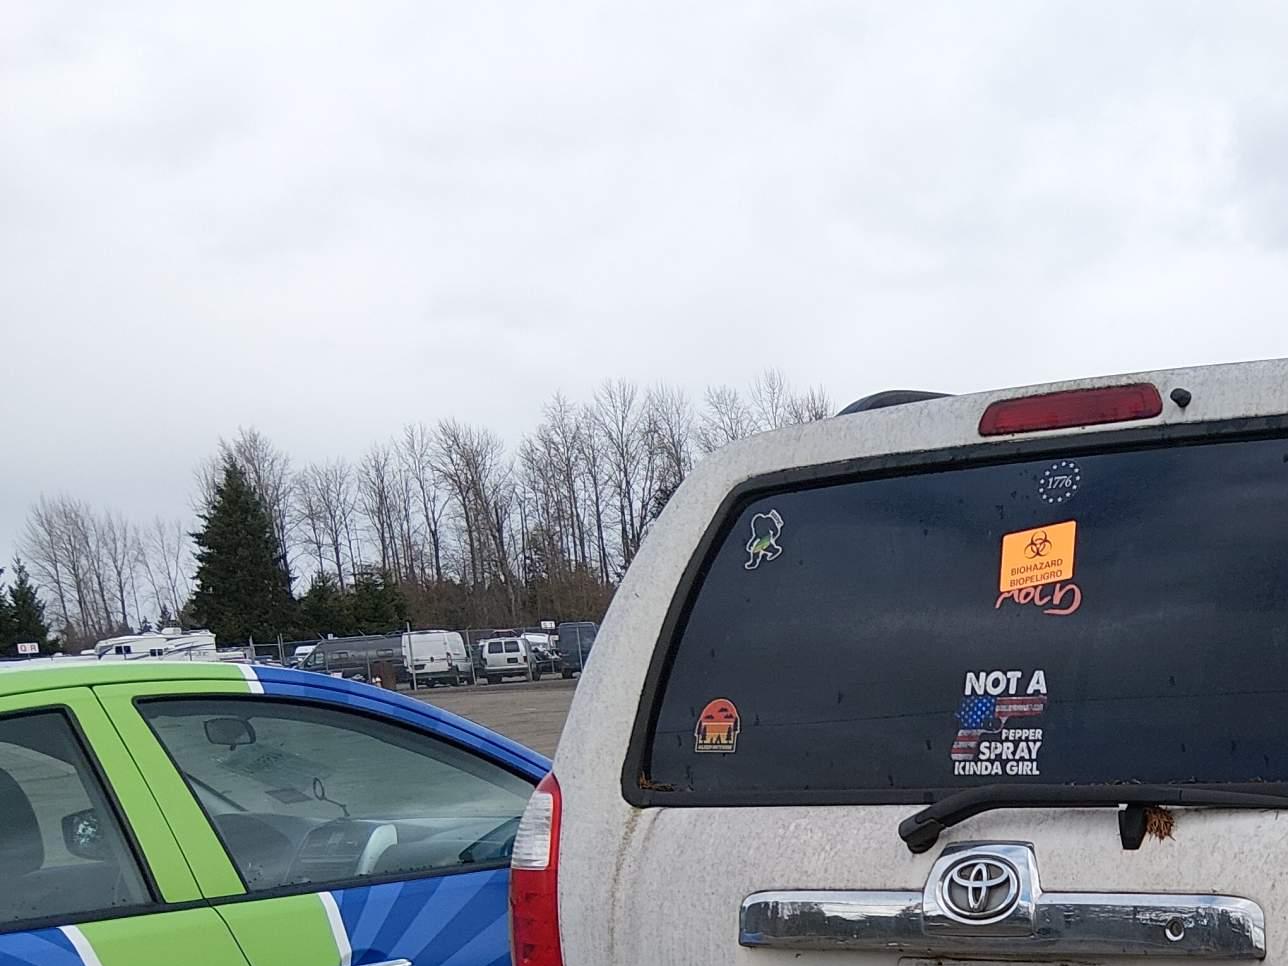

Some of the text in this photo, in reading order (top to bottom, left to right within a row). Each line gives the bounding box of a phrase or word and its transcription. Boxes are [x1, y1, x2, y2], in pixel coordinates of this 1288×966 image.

[1047, 475, 1073, 489] 1776
[1010, 559, 1064, 576] BIOHAZARD
[1009, 570, 1063, 588] BIOPELIGRO
[964, 670, 1047, 695] NOT A
[1001, 729, 1042, 740] PEPPER
[979, 741, 1042, 760] SPRAY
[954, 761, 1040, 775] KINDA GIRL
